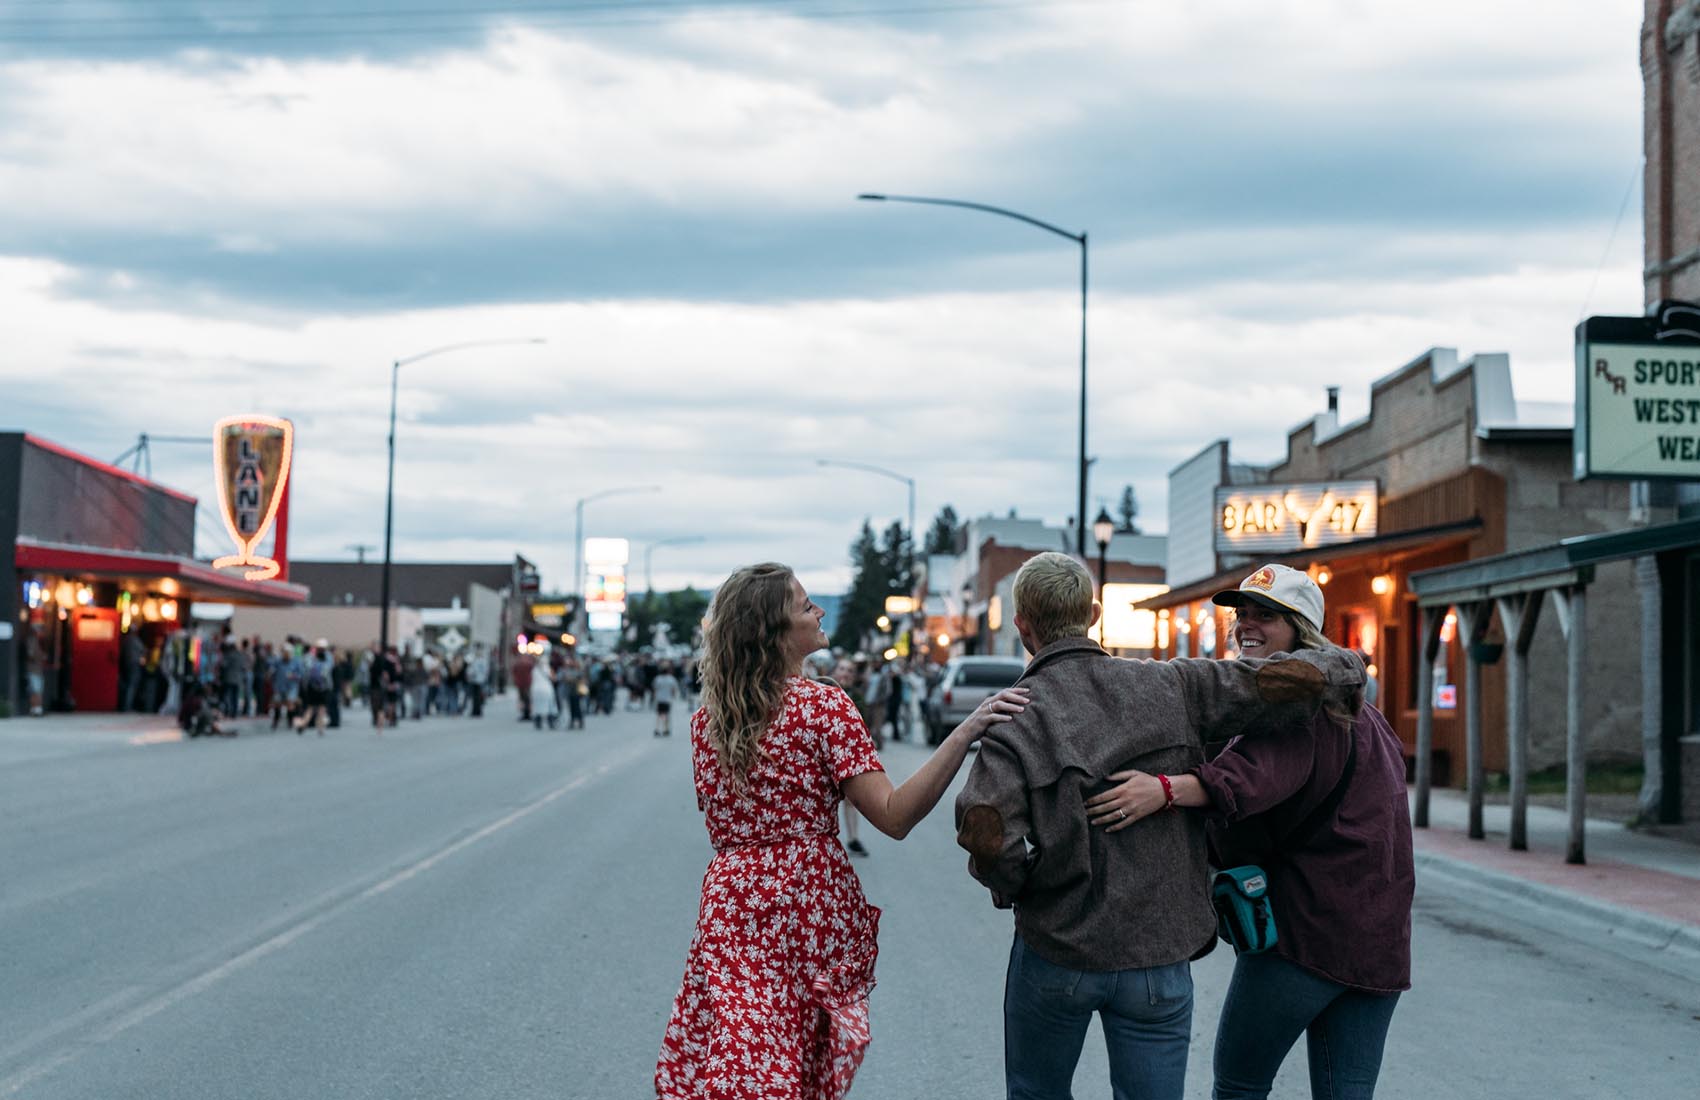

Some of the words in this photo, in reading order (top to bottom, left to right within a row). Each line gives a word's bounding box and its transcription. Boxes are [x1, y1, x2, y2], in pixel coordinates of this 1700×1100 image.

[1634, 398, 1700, 423] WEST
[238, 439, 260, 533] LANE
[1223, 502, 1278, 532] BAR
[1328, 502, 1362, 532] 47
